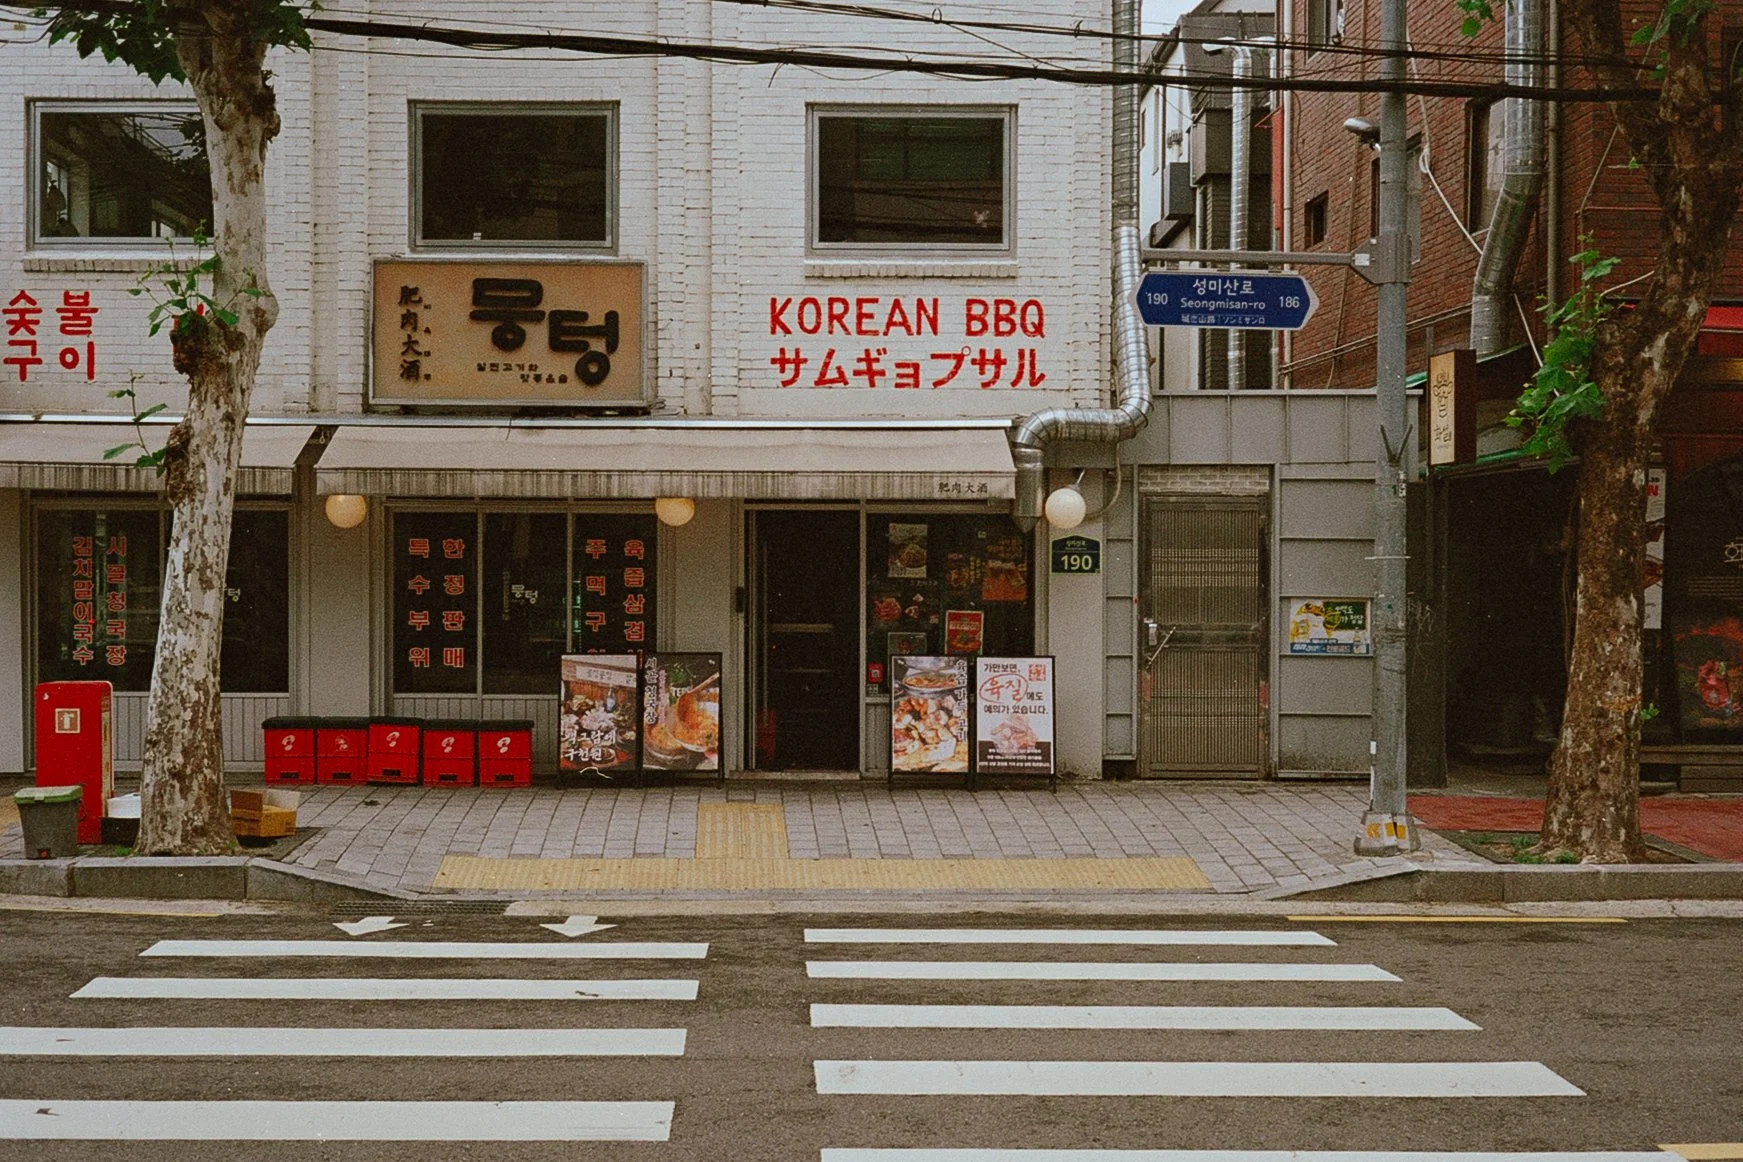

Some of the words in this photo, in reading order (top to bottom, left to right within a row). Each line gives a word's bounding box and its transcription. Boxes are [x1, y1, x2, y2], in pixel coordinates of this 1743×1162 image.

[1146, 292, 1169, 305] 190
[1180, 298, 1266, 311] Seongmisan-ro
[1279, 296, 1300, 309] 186
[1192, 278, 1255, 296] 성미산로
[2, 289, 100, 336] 숯불
[398, 285, 423, 382] 肥肉大酒
[469, 278, 620, 386] 뭉텅
[769, 297, 939, 337] KOREAN
[965, 298, 1045, 338] BBQ
[3, 340, 96, 382] 구이
[770, 345, 1047, 389] サムギョプサル
[1061, 555, 1092, 571] 190
[72, 536, 95, 666] 김치말이국수
[105, 536, 128, 666] 시골청국장
[408, 538, 431, 668] 특수부위
[442, 538, 465, 668] 한정판매
[511, 584, 538, 604] 뭉텅
[585, 539, 607, 653] 주먹구
[984, 705, 1010, 715] 예의가
